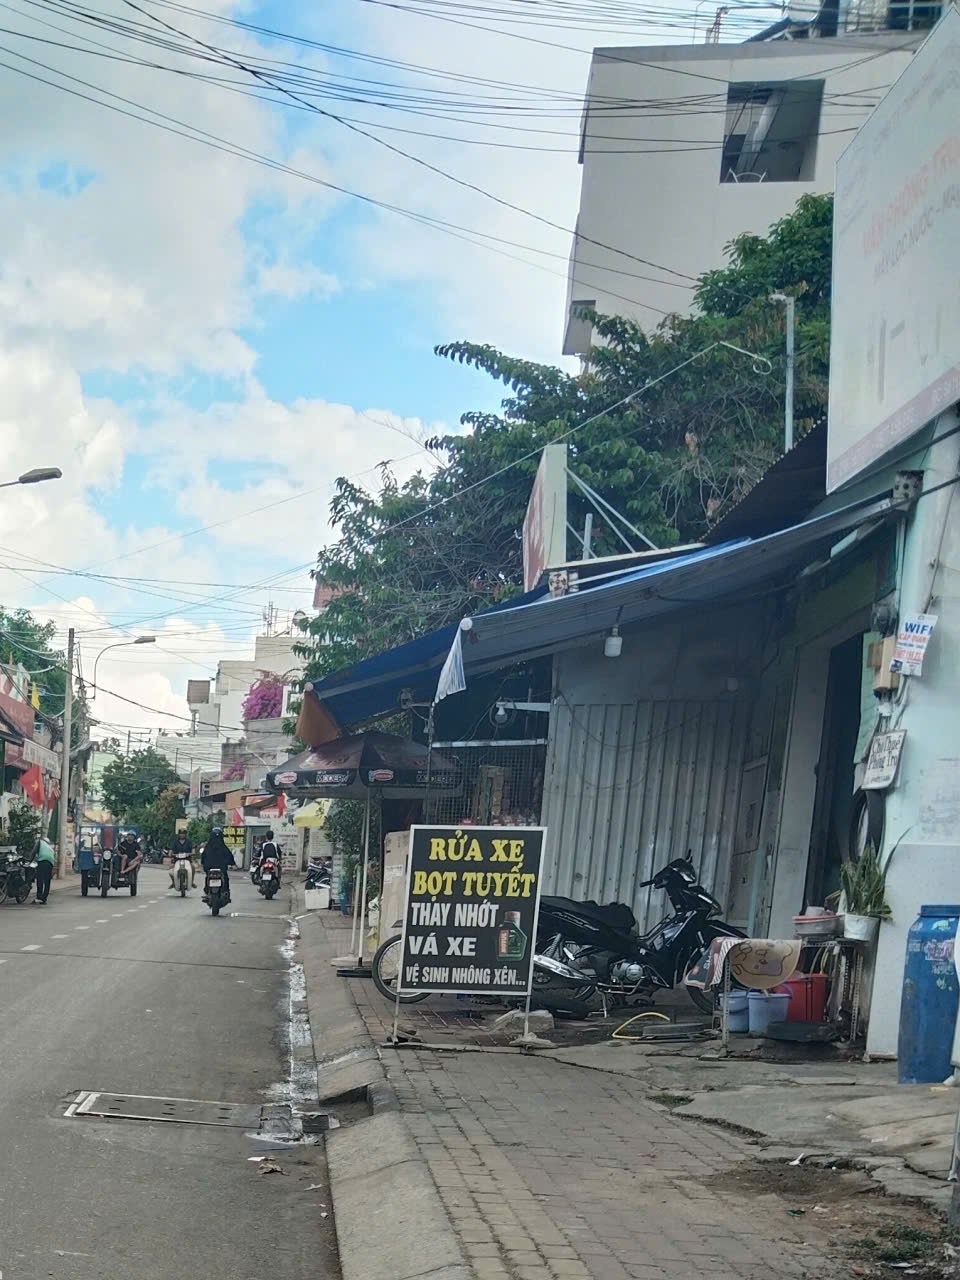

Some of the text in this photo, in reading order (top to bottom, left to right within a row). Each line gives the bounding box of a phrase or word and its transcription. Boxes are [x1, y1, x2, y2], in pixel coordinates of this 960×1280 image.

[429, 830, 525, 862] RỬA XE
[412, 862, 535, 901] BỌT TUYẾT
[411, 899, 499, 928] THAY NHỚT
[408, 932, 476, 956] VÁ XE
[406, 963, 419, 986] VỆ
[422, 966, 449, 984] SINH
[452, 964, 490, 985] NHÔNG
